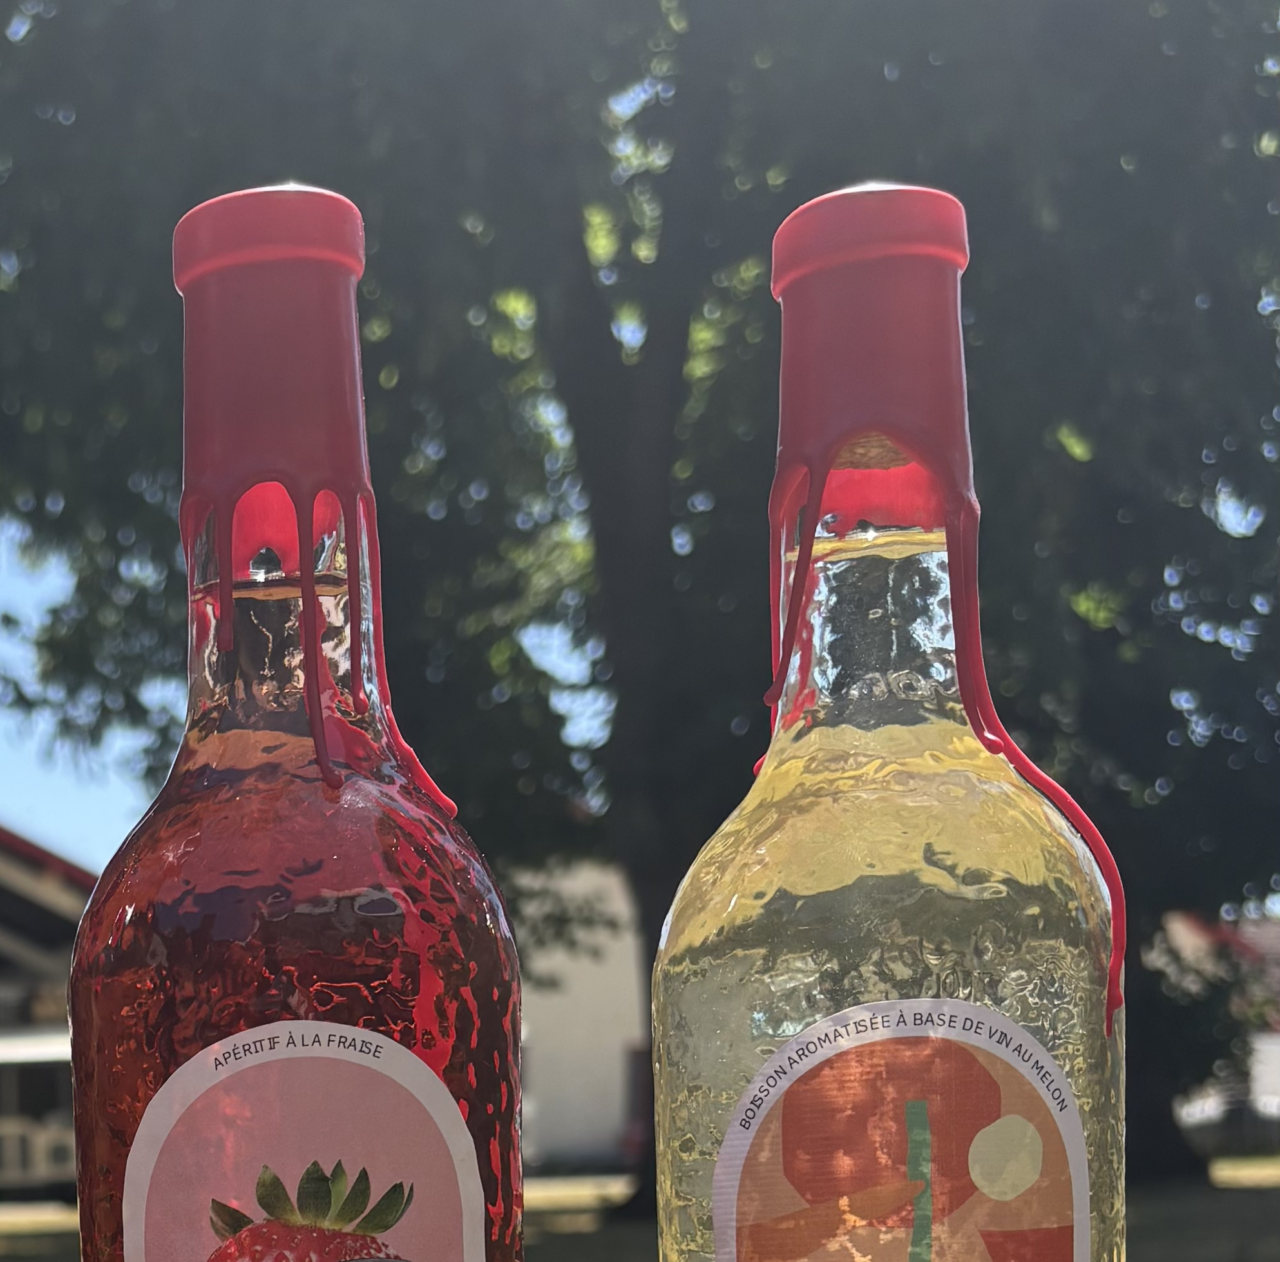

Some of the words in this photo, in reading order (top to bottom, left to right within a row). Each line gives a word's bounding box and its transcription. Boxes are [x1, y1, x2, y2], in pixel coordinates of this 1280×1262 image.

[213, 1036, 281, 1071] APÉRITIF
[286, 1031, 297, 1048] À
[302, 1034, 321, 1047] LA
[327, 1033, 384, 1059] FRAISE
[739, 1064, 788, 1131] BOISSON
[786, 1012, 891, 1070] AROMATISÉE
[896, 1010, 907, 1026] À
[913, 1012, 957, 1029] BASE
[963, 1017, 985, 1035] DE
[987, 1025, 1012, 1048] VIN
[1011, 1043, 1033, 1063] AU
[1030, 1060, 1068, 1113] MELON
